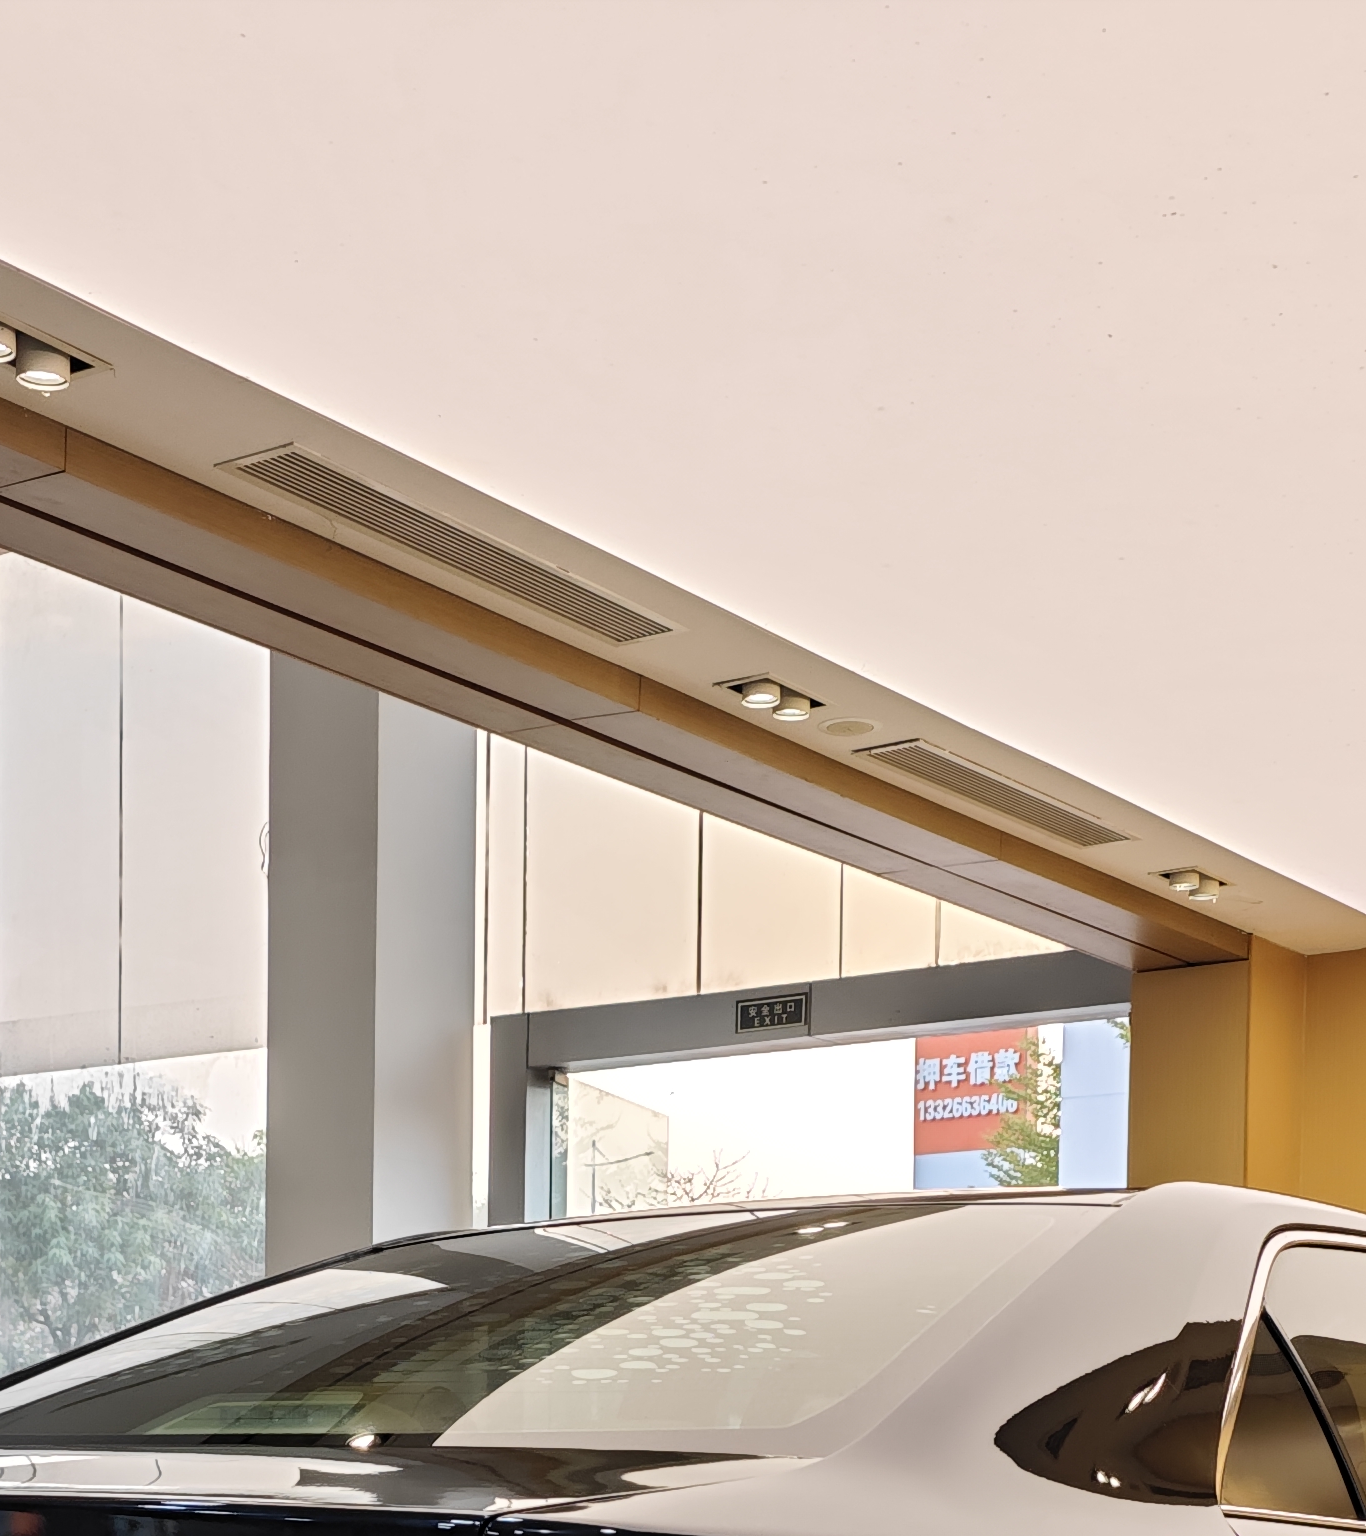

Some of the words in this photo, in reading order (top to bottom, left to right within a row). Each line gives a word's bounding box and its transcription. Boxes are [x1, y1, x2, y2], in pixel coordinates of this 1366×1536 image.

[748, 1002, 795, 1018] 安全出口
[754, 1014, 788, 1027] EXIT
[916, 1048, 1021, 1090] 押车借款
